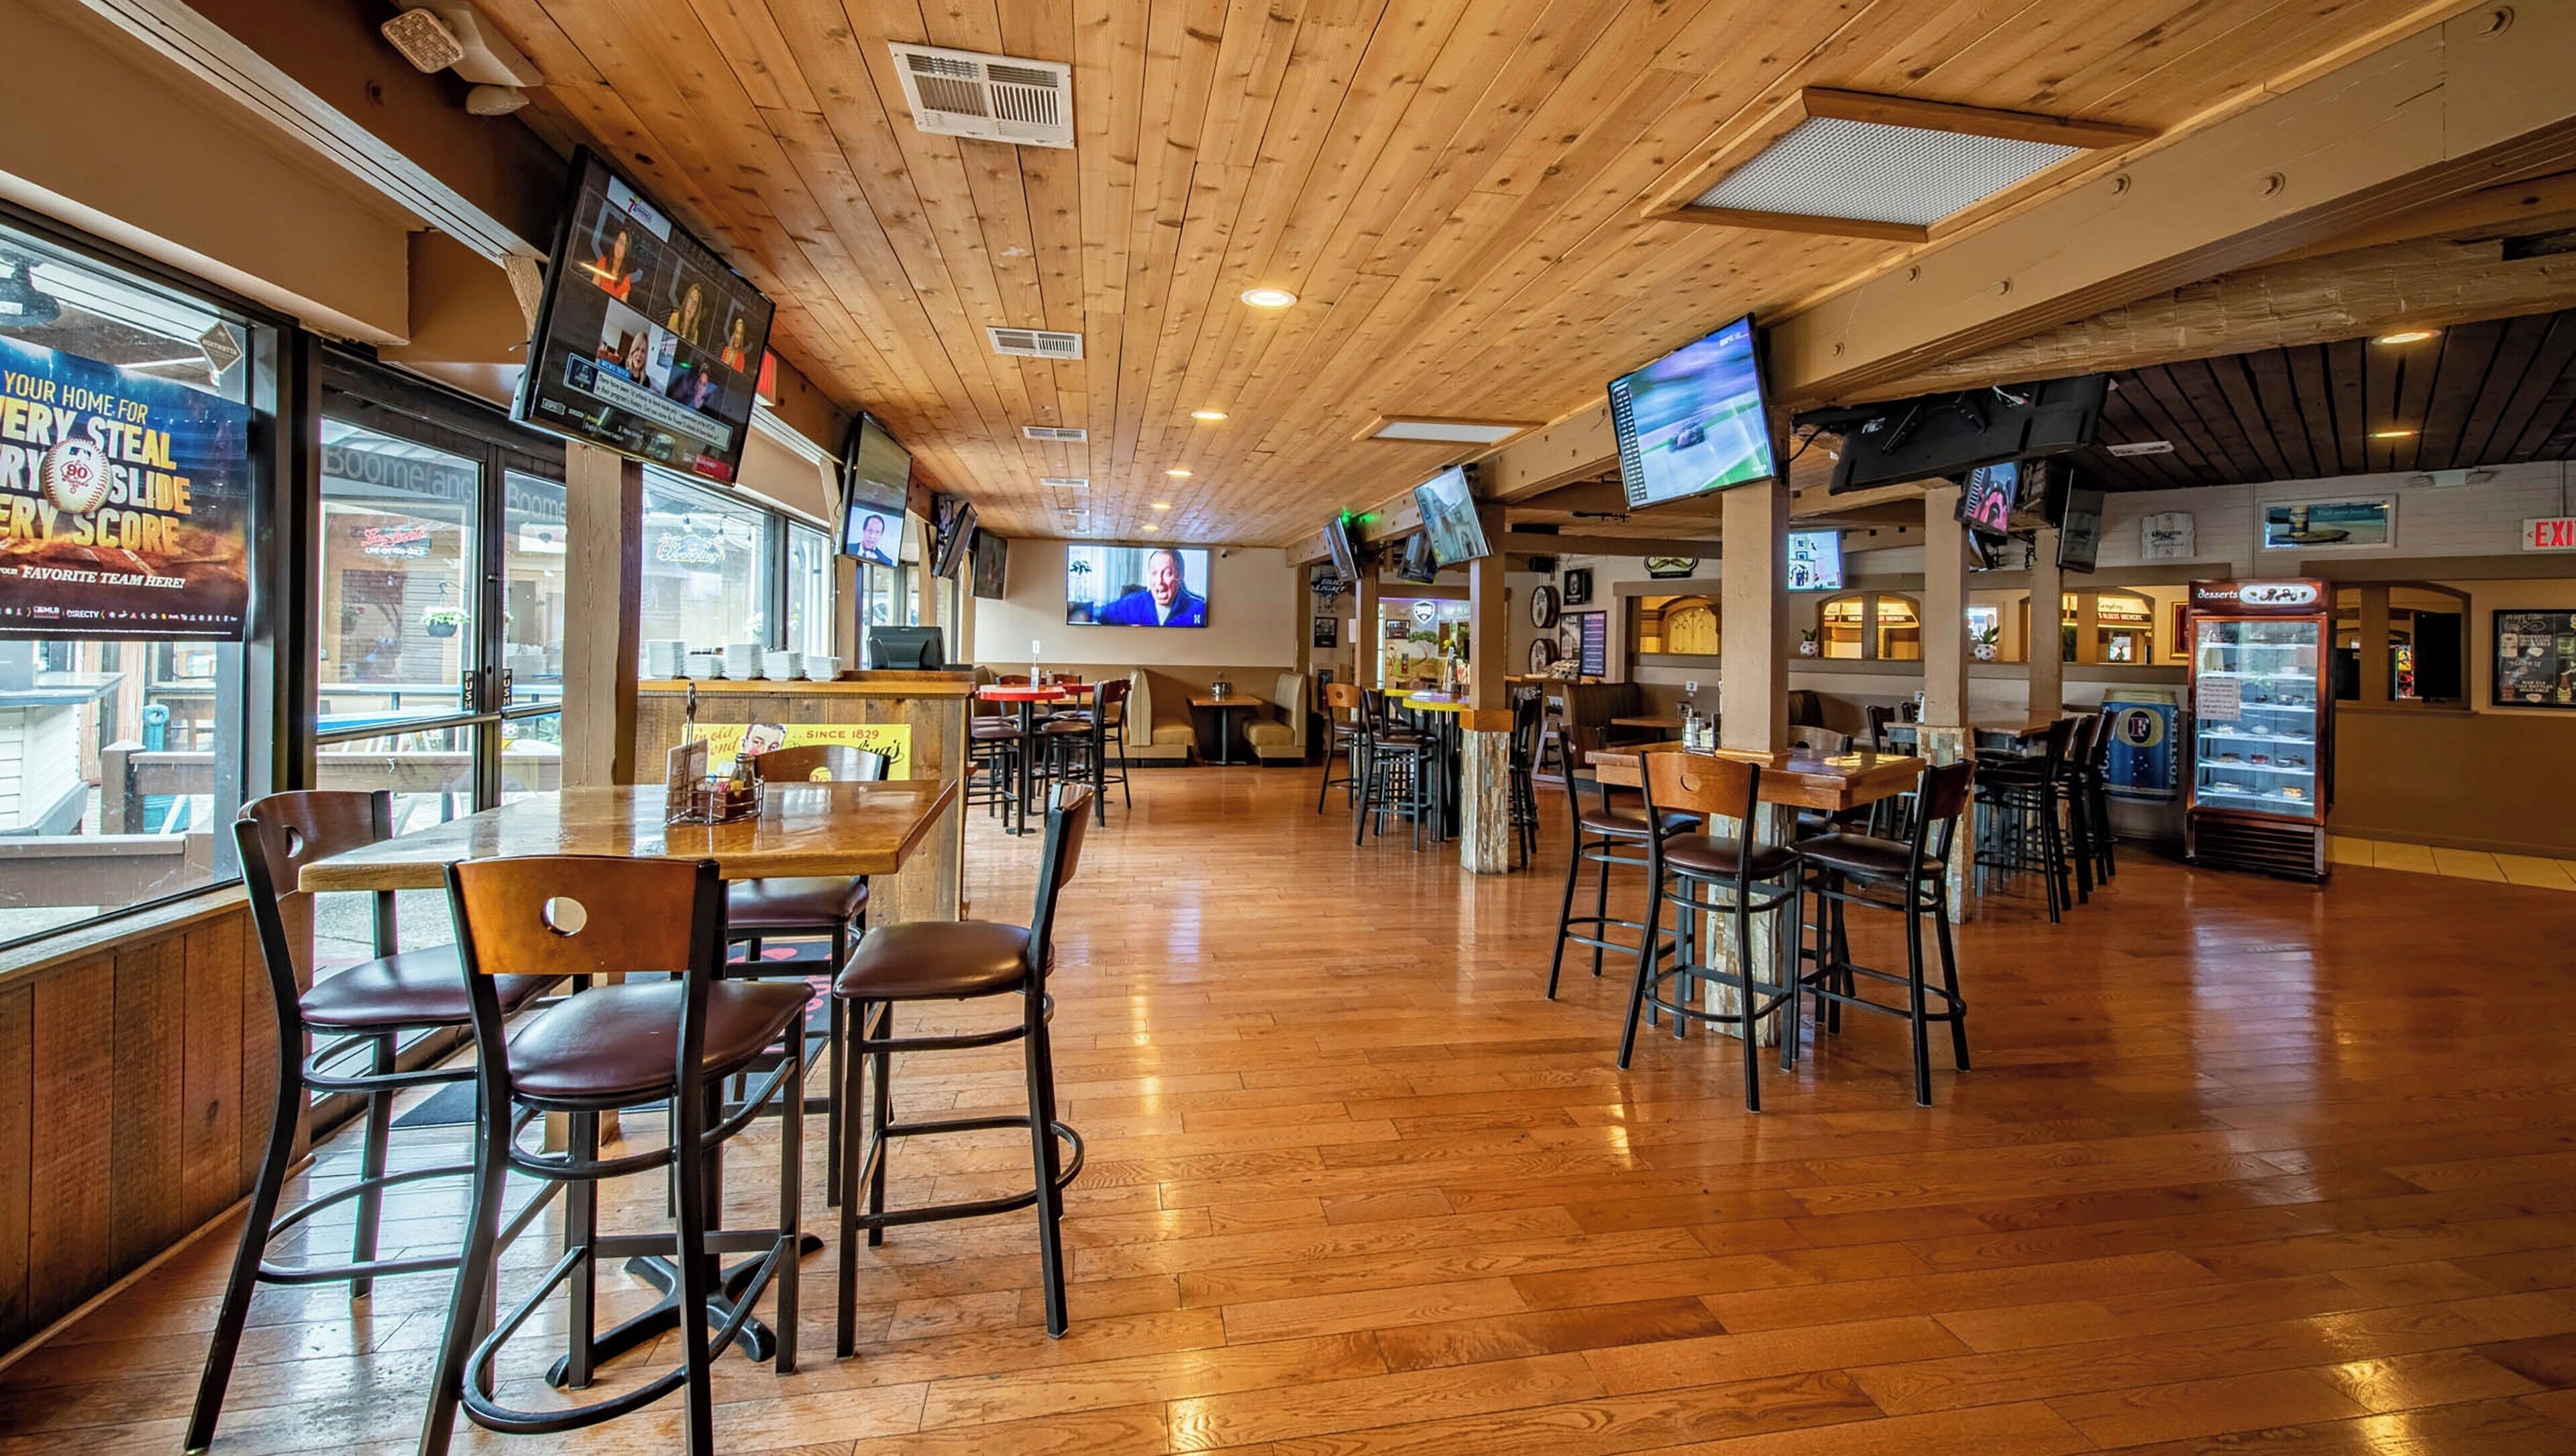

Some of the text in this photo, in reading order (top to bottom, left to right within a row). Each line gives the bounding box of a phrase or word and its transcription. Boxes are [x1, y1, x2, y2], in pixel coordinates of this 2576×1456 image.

[4, 370, 149, 425] YOUR HOME FOR
[0, 395, 176, 470] ERY STEAL
[67, 464, 88, 478] 90
[109, 464, 192, 515] SLIDE
[72, 508, 182, 556] SCORE
[2535, 520, 2576, 547] EXI
[22, 567, 97, 583] FAVORITE
[100, 572, 143, 586] TEAM
[144, 576, 186, 588] HERE!
[1321, 578, 1344, 586] BUD
[1311, 584, 1345, 594] LIGHT
[2198, 588, 2239, 599] desserts
[66, 609, 99, 619] DIRECTV
[710, 727, 735, 741] old
[806, 730, 846, 739] SINCE
[852, 729, 879, 739] 1829
[2130, 717, 2149, 737] F
[2169, 707, 2179, 784] FOSTER'S
